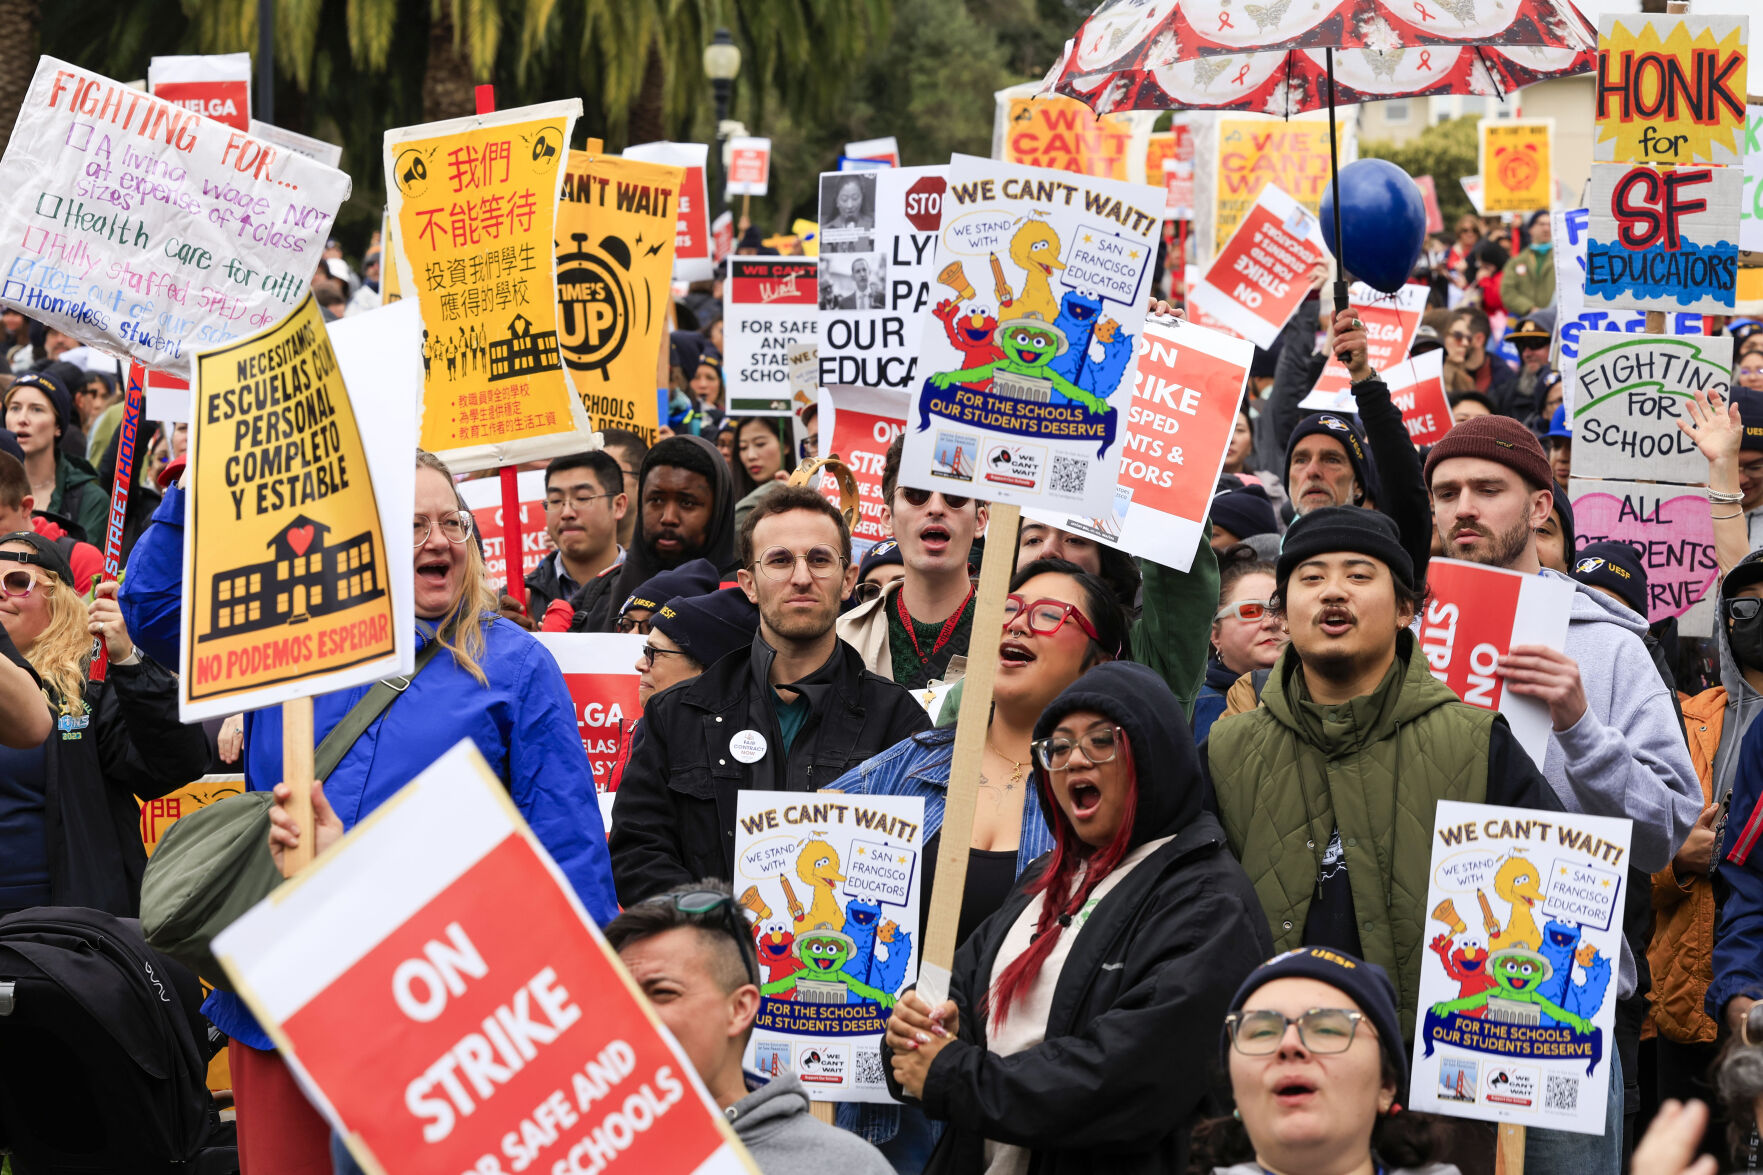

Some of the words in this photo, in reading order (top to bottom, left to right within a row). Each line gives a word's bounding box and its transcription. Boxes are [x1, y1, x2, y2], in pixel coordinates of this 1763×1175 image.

[1596, 48, 1746, 126] HONK
[48, 70, 201, 153] FIGHTING
[1040, 109, 1106, 131] WE
[1251, 133, 1312, 152] WE
[1639, 126, 1688, 157] for
[447, 141, 511, 193] 我們
[77, 178, 133, 211] sizes
[95, 135, 112, 160] A
[123, 145, 187, 182] living
[202, 179, 271, 216] wage
[282, 203, 331, 234] NOT
[560, 173, 610, 207] AN'T
[616, 181, 672, 218] WAIT
[1225, 174, 1326, 195] WAIT
[86, 161, 112, 181] at
[119, 173, 201, 215] expense
[208, 207, 231, 229] of
[252, 222, 307, 252] class
[415, 187, 537, 251] 不能等待
[907, 193, 945, 215] STO
[952, 179, 996, 206] WE
[1000, 178, 1078, 206] CAN'T
[1084, 190, 1157, 237] WAIT!
[1611, 167, 1712, 252] SF
[953, 224, 973, 236] WE
[976, 220, 1012, 234] STAND
[969, 236, 998, 248] WITH
[63, 202, 150, 250] Health
[164, 237, 213, 270] care
[222, 257, 258, 288] for
[1098, 239, 1124, 256] SAN
[46, 235, 101, 281] Fully
[105, 261, 190, 306] staffed
[198, 286, 247, 321] SPED
[425, 242, 536, 292] 投資我們學生
[742, 265, 768, 275] WE
[1075, 250, 1136, 278] FRANCISCO
[1233, 254, 1290, 298] STRIKE
[1272, 261, 1294, 281] FOR
[1588, 251, 1736, 291] EDUCATORS
[1067, 265, 1133, 295] EDUCATORS
[1233, 282, 1262, 308] ON
[39, 265, 80, 296] ICE
[87, 284, 126, 314] out
[129, 301, 154, 321] of
[158, 312, 197, 336] our
[440, 276, 530, 322] 應得的學校
[26, 288, 113, 333] Homeless
[118, 322, 182, 360] student
[558, 302, 614, 347] UP
[741, 321, 772, 334] FOR
[780, 321, 818, 334] SAFE
[827, 317, 905, 350] OUR
[237, 320, 313, 383] NECESITAMOS
[761, 337, 798, 350] AND
[790, 351, 811, 365] WE
[1579, 350, 1729, 403] FIGHTING
[207, 366, 310, 425] ESCUELAS
[578, 393, 635, 420] CHOOLS
[956, 391, 983, 406] FOR
[987, 396, 1014, 414] THE
[1016, 403, 1084, 422] SCHOOLS
[1132, 375, 1202, 416] RIKE
[1628, 392, 1681, 420] FOR
[234, 384, 335, 452] PERSONAL
[930, 399, 961, 418] OUR
[963, 407, 1038, 434] STUDENTS
[1041, 421, 1106, 436] DESERVE
[1128, 406, 1180, 435] SPED
[1350, 434, 1363, 460] UESF
[1581, 418, 1698, 458] SCHOOL
[225, 420, 341, 488] COMPLETO
[1168, 446, 1184, 465] &
[105, 480, 126, 577] STREET
[119, 378, 142, 479] HOCKEY
[1012, 469, 1037, 477] WAIT
[230, 487, 245, 521] Y
[256, 456, 349, 515] ESTABLE
[1618, 495, 1672, 524] ALL
[1608, 562, 1631, 579] UESF
[633, 598, 656, 609] UESF
[196, 654, 223, 686] NO
[226, 633, 313, 677] PODEMOS
[317, 612, 390, 659] ESPERAR
[1464, 643, 1500, 707] ON
[741, 808, 778, 836] WE
[783, 804, 848, 825] CAN'T
[854, 807, 918, 843] WAIT!
[746, 853, 763, 864] WE
[765, 844, 795, 859] STAND
[871, 850, 893, 862] SAN
[1439, 821, 1478, 847] WE
[1483, 819, 1552, 842] CAN'T
[1557, 826, 1624, 867] WAIT!
[760, 859, 786, 873] WITH
[853, 862, 906, 881] FRANCISCO
[1443, 865, 1460, 876] WE
[1461, 858, 1494, 872] STAND
[1457, 874, 1484, 885] WITH
[1573, 870, 1596, 885] SAN
[848, 876, 905, 897] EDUCATORS
[1553, 882, 1608, 904] FRANCISCO
[1547, 897, 1607, 921] EDUCATORS
[392, 921, 489, 1023] ON
[1310, 949, 1356, 969] UESF
[756, 1015, 775, 1027] UR
[777, 1017, 839, 1031] STUDENTS
[767, 1003, 791, 1016] FOR
[793, 1004, 817, 1018] THE
[820, 1006, 877, 1018] SCHOOLS
[1433, 1026, 1460, 1044] OUR
[1463, 1033, 1531, 1055] STUDENTS
[1534, 1041, 1593, 1055] DESERVE
[1455, 1018, 1480, 1032] FOR
[1483, 1023, 1507, 1038] THE
[1510, 1027, 1571, 1042] SCHOOLS
[405, 967, 582, 1143] STRIKE
[501, 1089, 579, 1172] SAFE
[571, 1040, 636, 1114] AND
